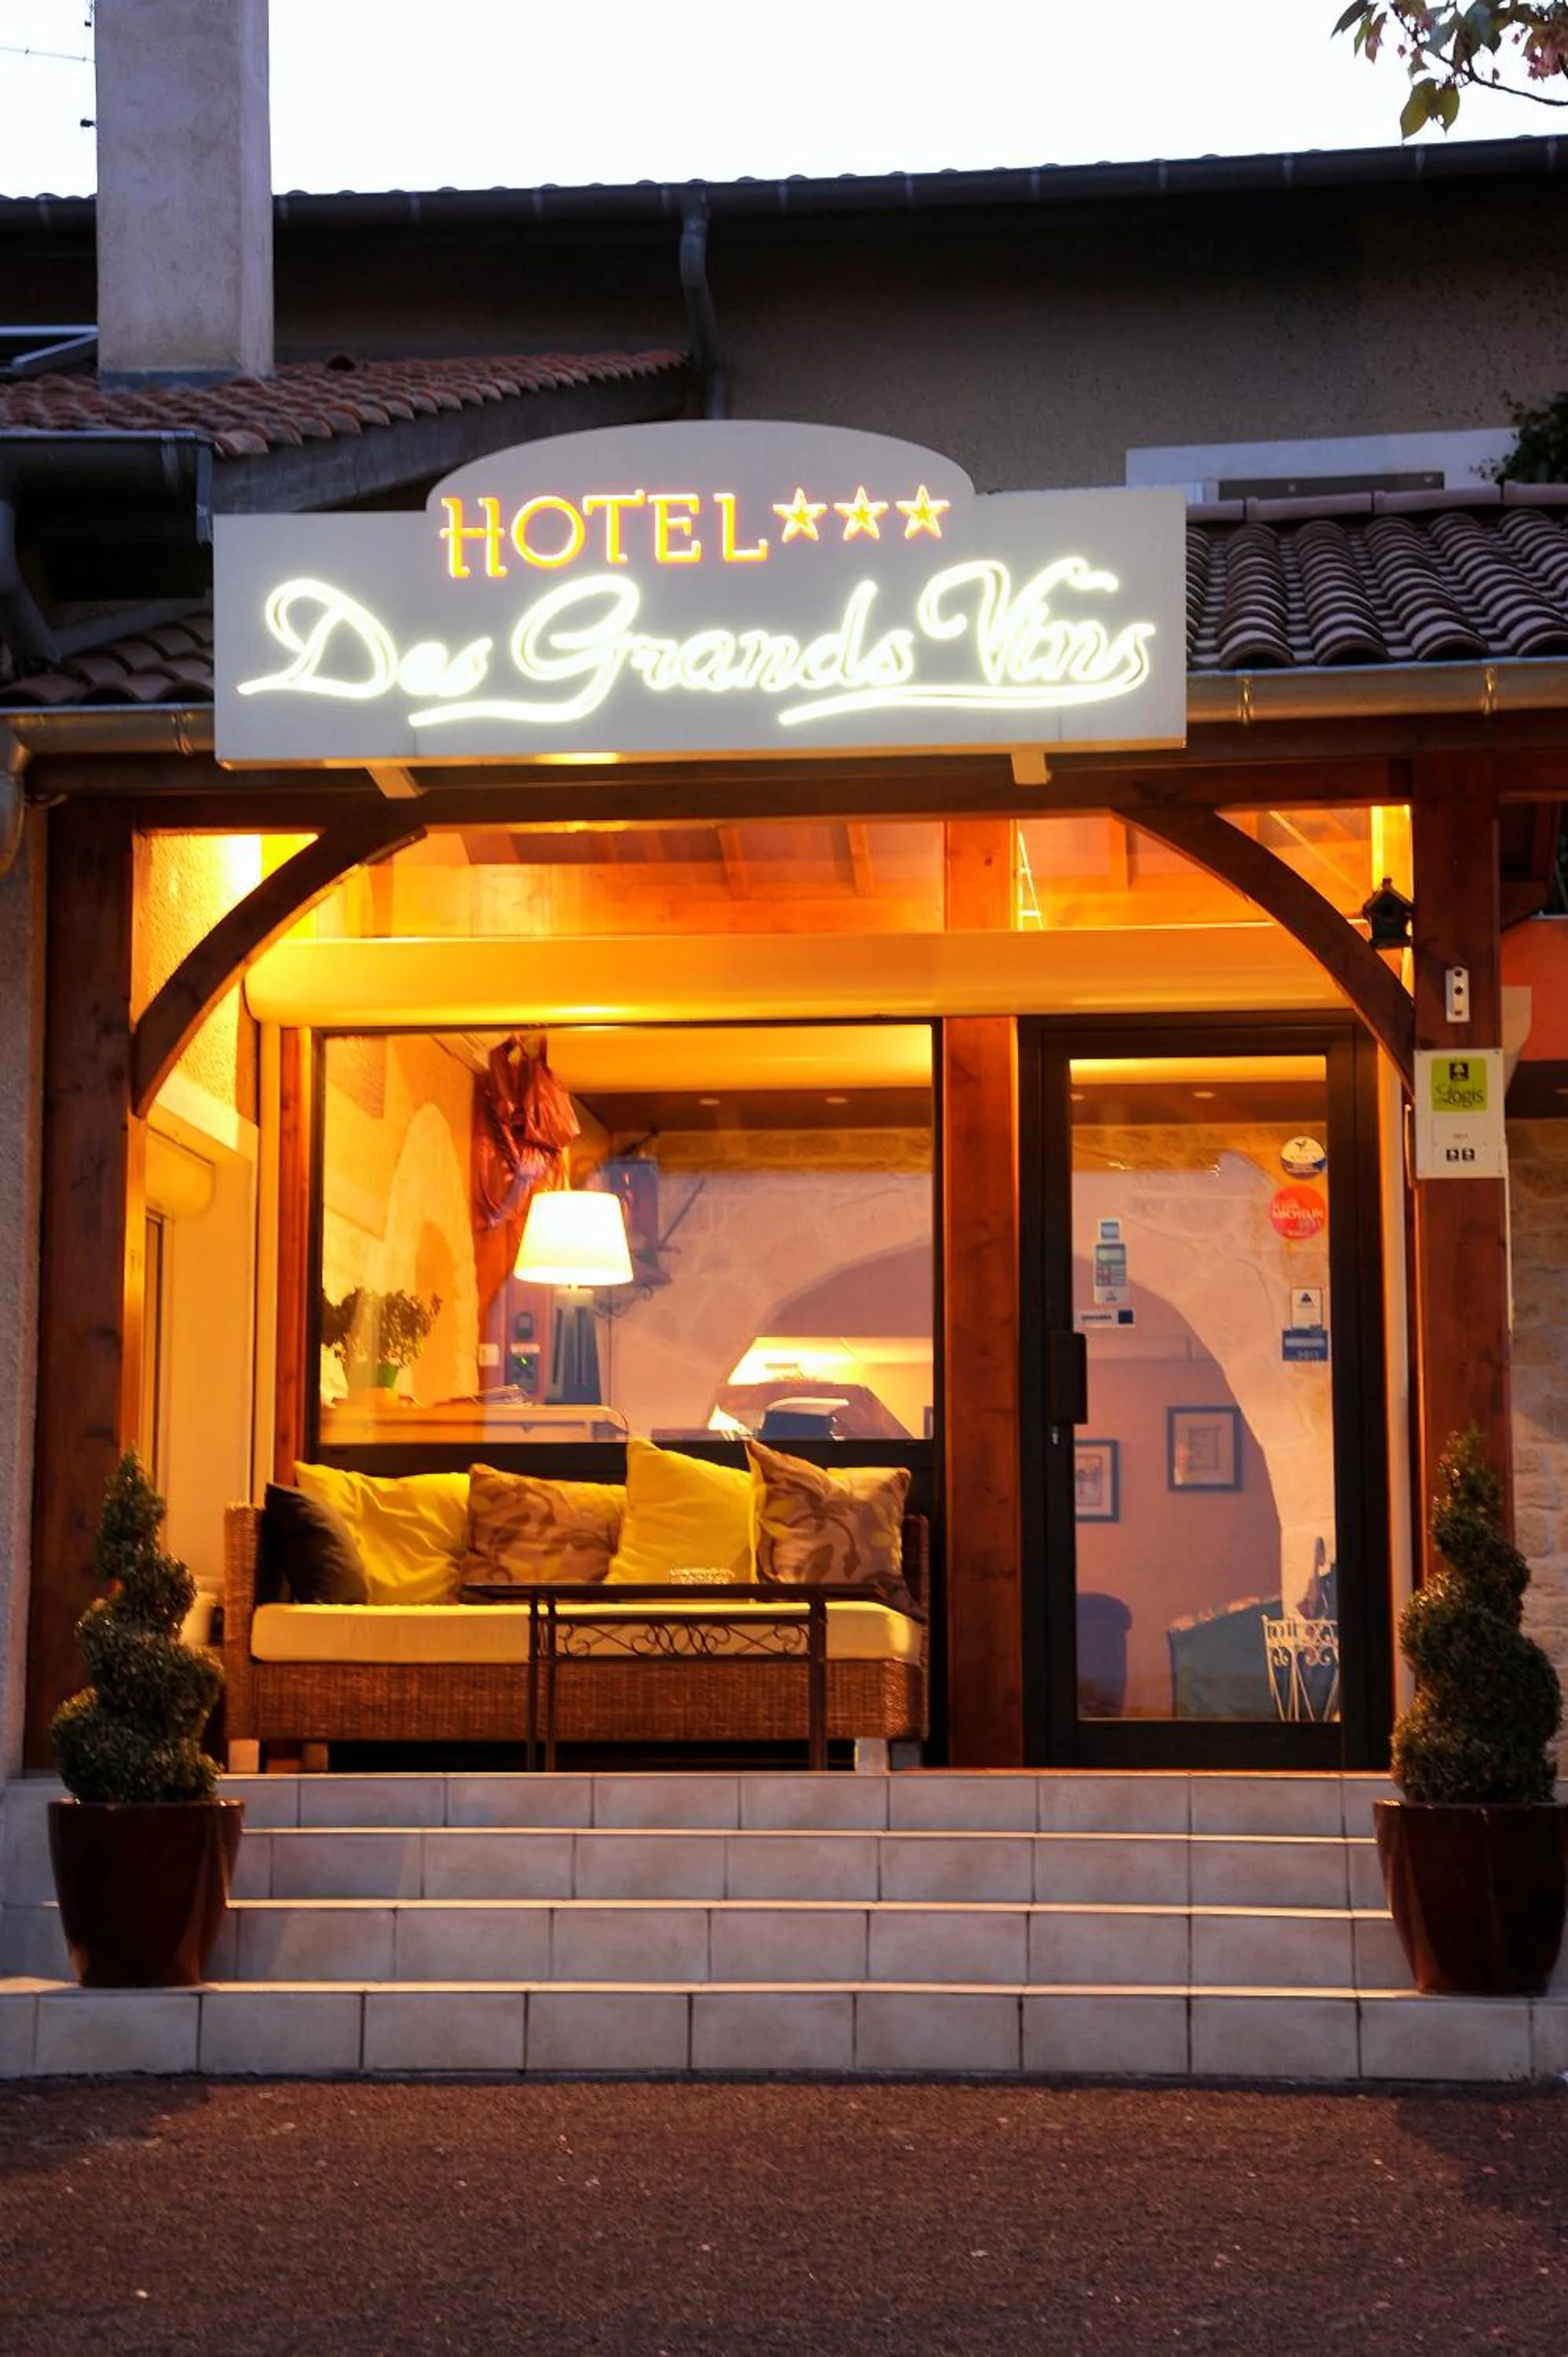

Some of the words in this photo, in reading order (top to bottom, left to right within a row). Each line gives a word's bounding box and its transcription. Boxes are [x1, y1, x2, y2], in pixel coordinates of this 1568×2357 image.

[438, 488, 768, 577] HOTEL
[237, 577, 493, 699] Des
[407, 573, 914, 726] Grands
